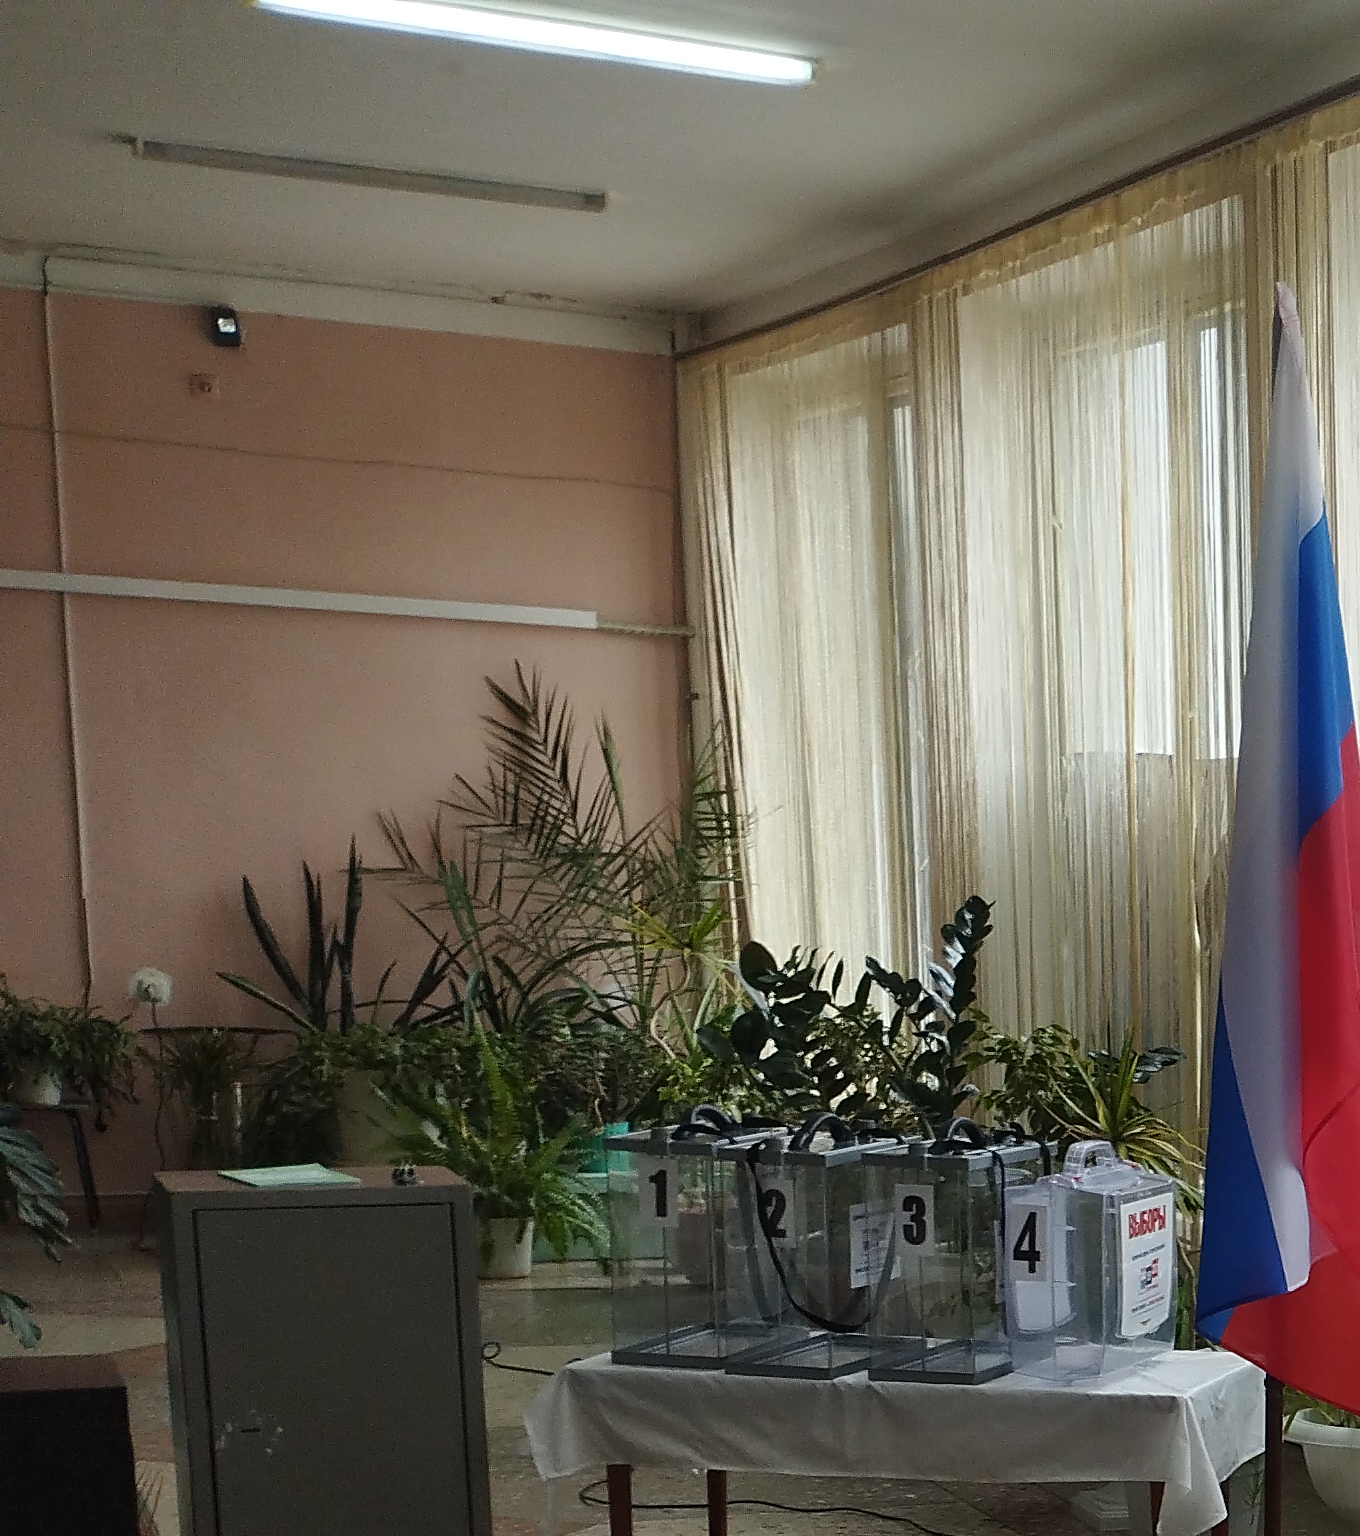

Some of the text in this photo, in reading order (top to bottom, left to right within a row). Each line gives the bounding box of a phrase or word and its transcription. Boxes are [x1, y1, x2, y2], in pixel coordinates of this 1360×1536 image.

[649, 1169, 668, 1217] 1
[760, 1189, 787, 1238] 2
[902, 1195, 927, 1246] 3
[1013, 1211, 1041, 1274] 4
[1128, 1204, 1167, 1239] ВЫБОРЫ
